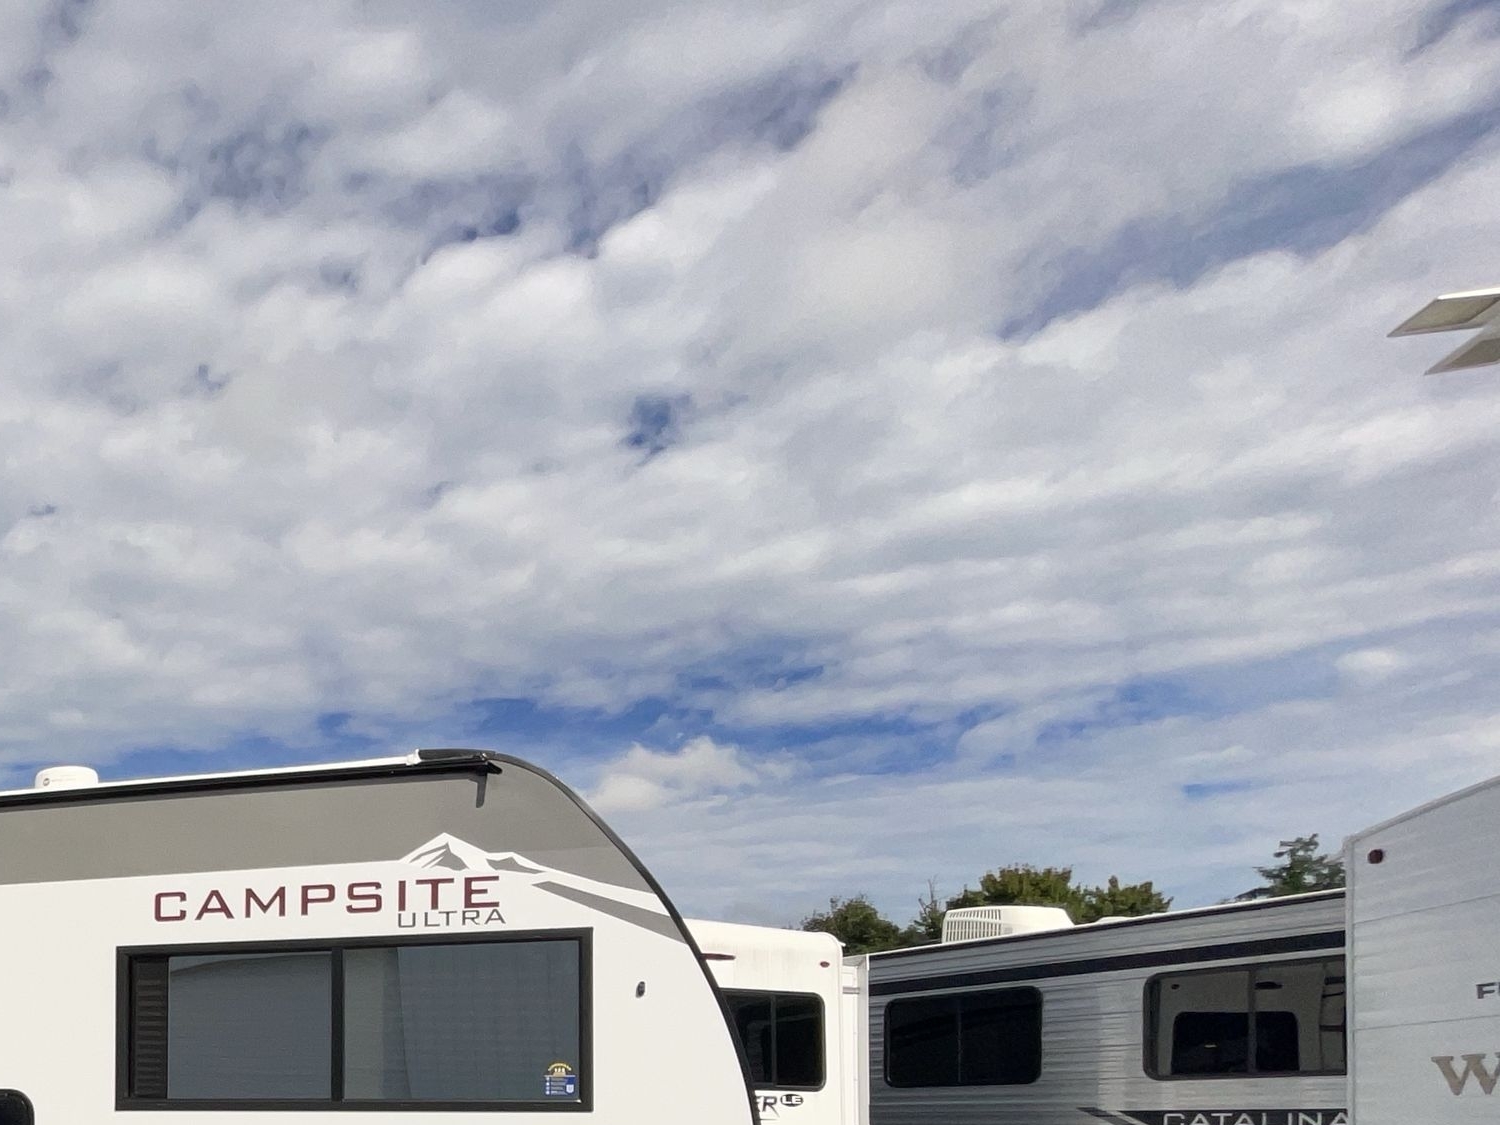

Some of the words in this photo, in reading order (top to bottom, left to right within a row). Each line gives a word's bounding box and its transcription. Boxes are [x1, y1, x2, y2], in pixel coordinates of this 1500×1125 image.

[153, 875, 501, 922] CAMPSITE
[397, 908, 506, 928] ULTRA
[1476, 982, 1500, 999] F
